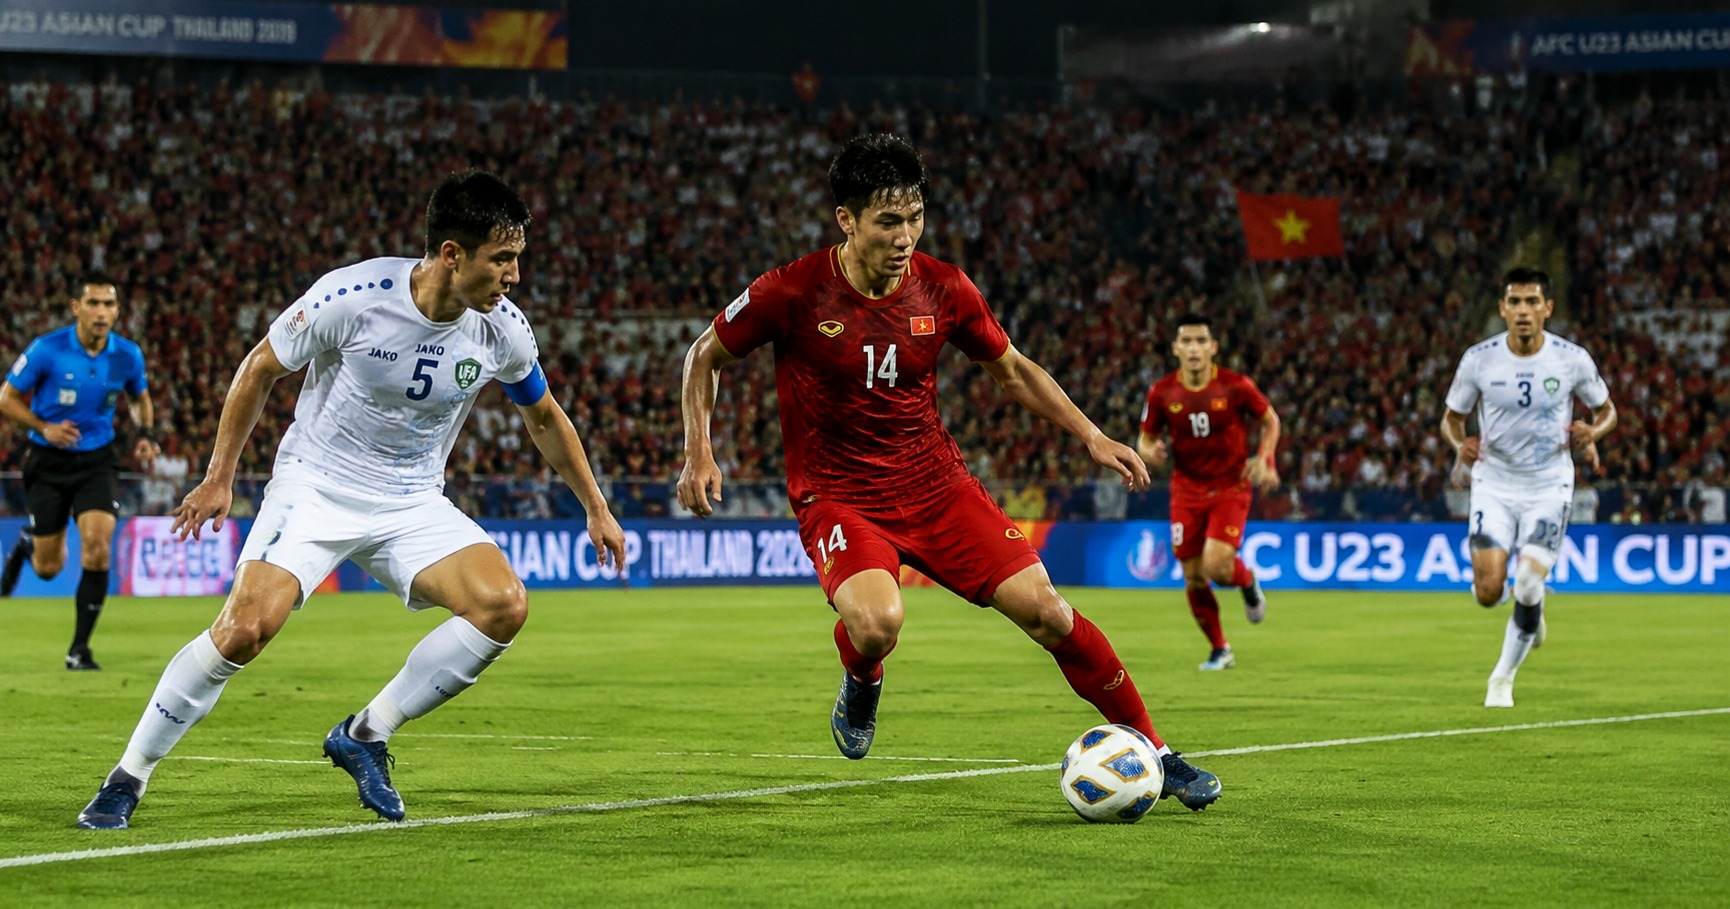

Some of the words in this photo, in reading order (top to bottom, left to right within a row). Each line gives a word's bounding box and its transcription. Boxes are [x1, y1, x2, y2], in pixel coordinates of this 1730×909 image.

[41, 11, 115, 36] ASIAN
[119, 14, 166, 37] CUP
[1531, 33, 1574, 56] AFC
[1578, 31, 1620, 55] U23
[1624, 28, 1694, 54] ASIAN
[1696, 27, 1730, 51] CU
[368, 348, 398, 361] JAKO
[415, 344, 445, 356] JAKO
[405, 358, 439, 401] 5
[863, 344, 898, 389] 14
[1517, 380, 1532, 408] 3
[1189, 412, 1210, 438] 19
[647, 530, 753, 578] THAILAND
[818, 524, 847, 564] 14
[1294, 531, 1406, 582] U23
[1612, 533, 1730, 585] CUP
